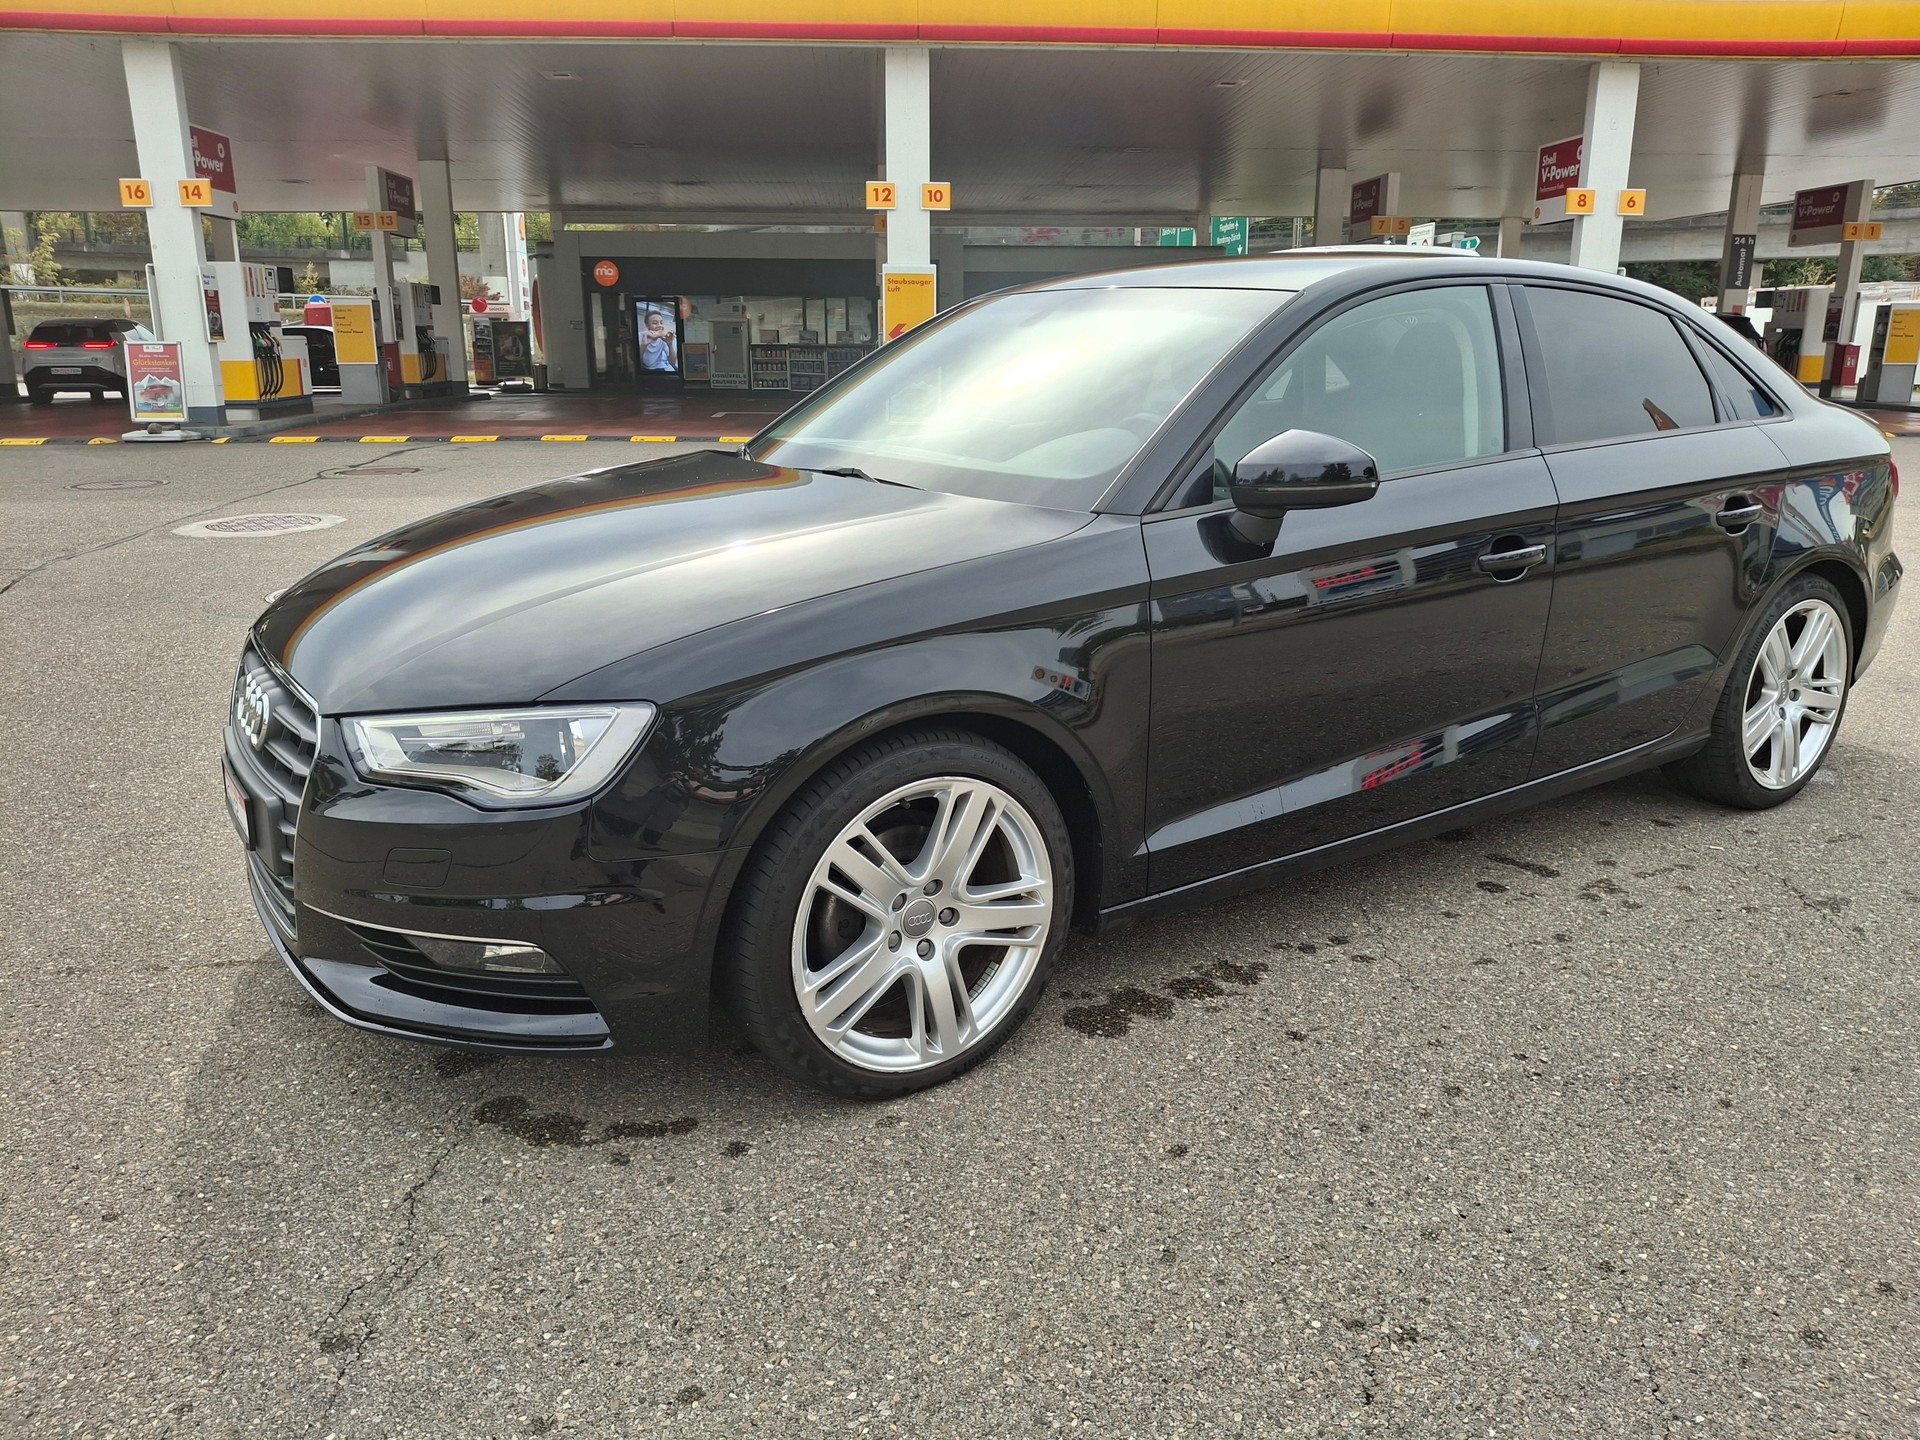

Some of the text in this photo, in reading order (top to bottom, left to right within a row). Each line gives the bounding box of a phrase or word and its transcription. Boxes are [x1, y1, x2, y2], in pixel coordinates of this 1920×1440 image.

[1542, 152, 1557, 167] Shell
[1541, 163, 1580, 183] V-Power
[125, 184, 145, 200] 16
[182, 184, 203, 200] 14
[873, 187, 892, 202] 12
[927, 189, 944, 203] 10
[1577, 193, 1587, 208] 8
[1626, 195, 1636, 208] 6
[1798, 205, 1835, 218] V-Power
[357, 215, 370, 226] 15
[379, 215, 393, 226] 13
[1378, 220, 1385, 230] 7
[1399, 220, 1405, 230] 5
[1851, 225, 1858, 236] 3
[1870, 226, 1875, 236] 1
[1734, 235, 1754, 245] 24 h
[1734, 248, 1747, 287] Automat
[887, 278, 932, 287] Staubsauger
[132, 358, 177, 366] Glückstanken
